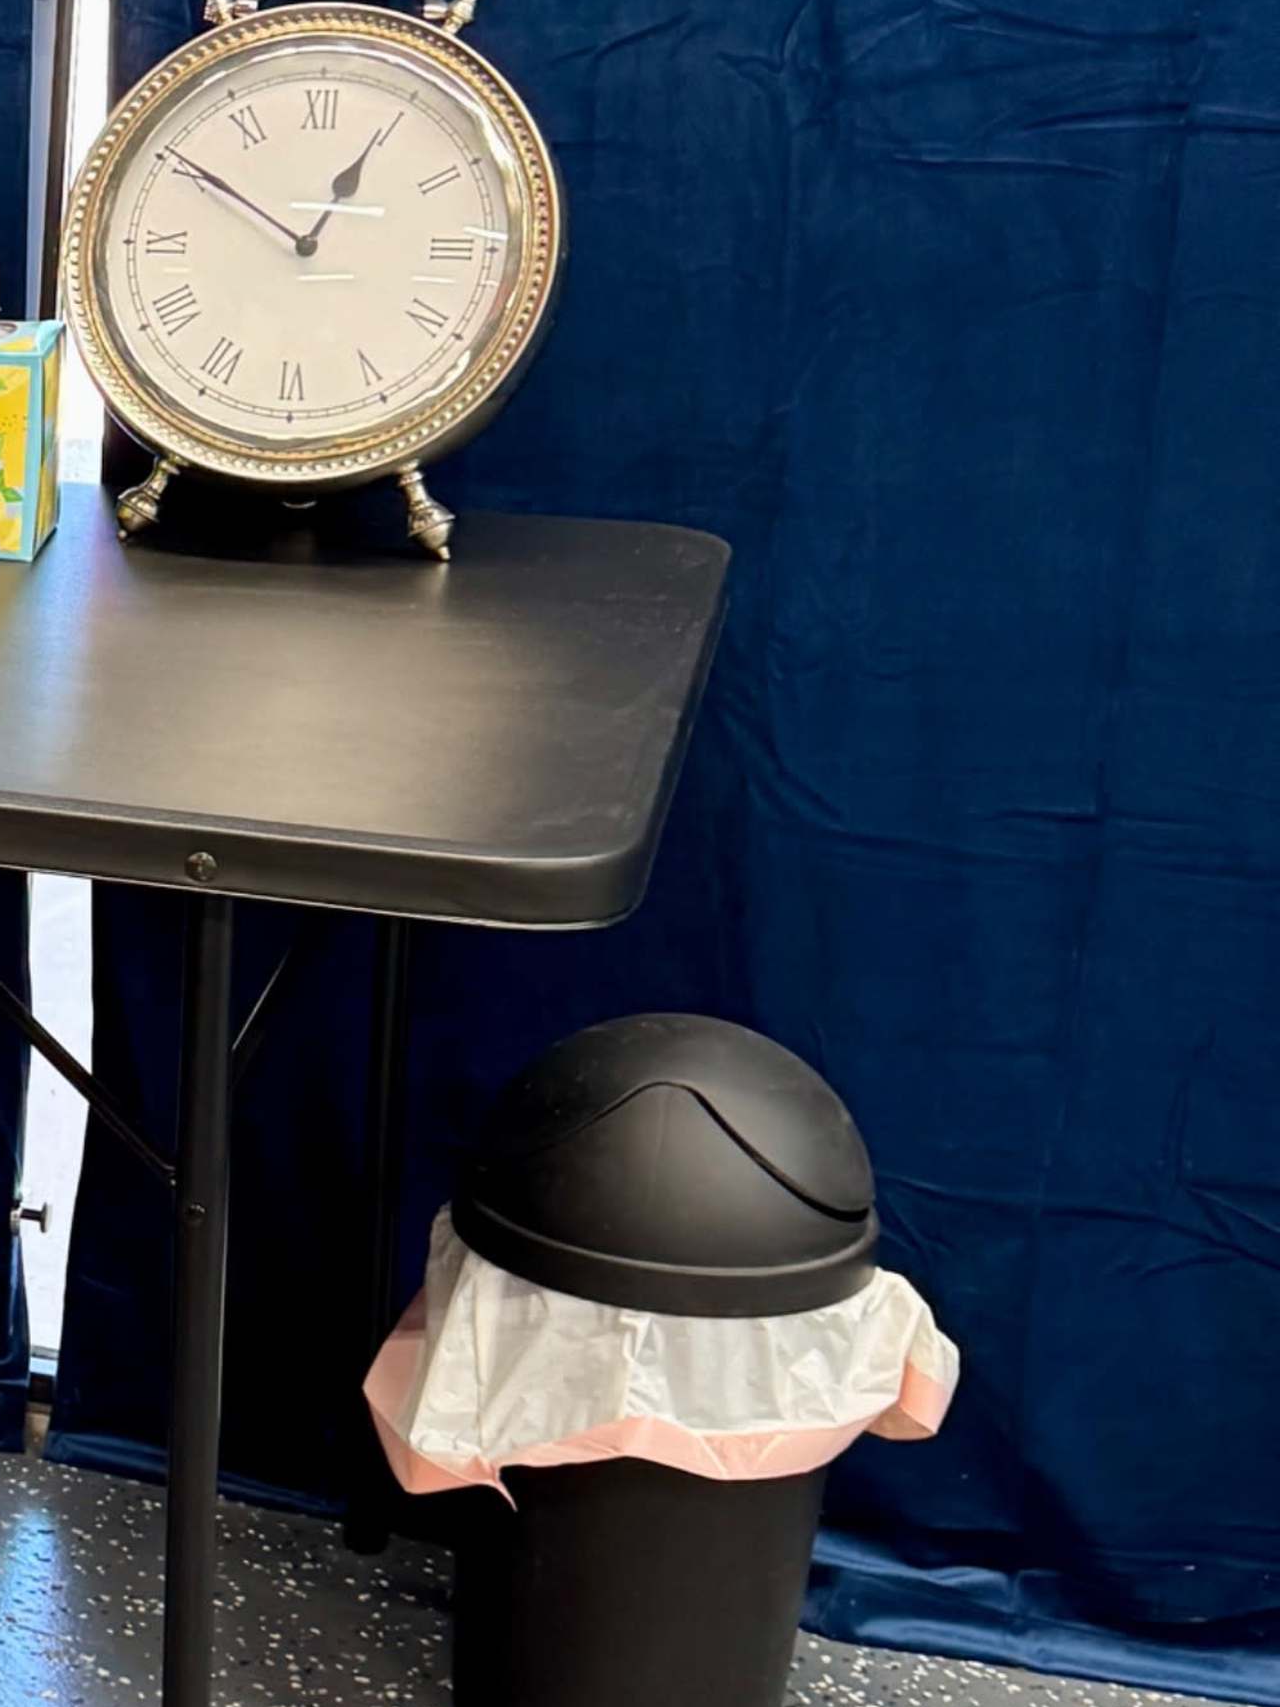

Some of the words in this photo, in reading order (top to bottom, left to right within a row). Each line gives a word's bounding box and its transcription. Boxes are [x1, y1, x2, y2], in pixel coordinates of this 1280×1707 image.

[228, 105, 267, 150] XI
[301, 89, 338, 130] XII
[417, 165, 461, 194] II
[145, 230, 188, 255] IX
[429, 237, 475, 261] III
[152, 284, 201, 336] VIII
[405, 297, 449, 338] IV
[199, 337, 243, 385] VII
[278, 361, 304, 401] VI
[357, 348, 383, 386] V
